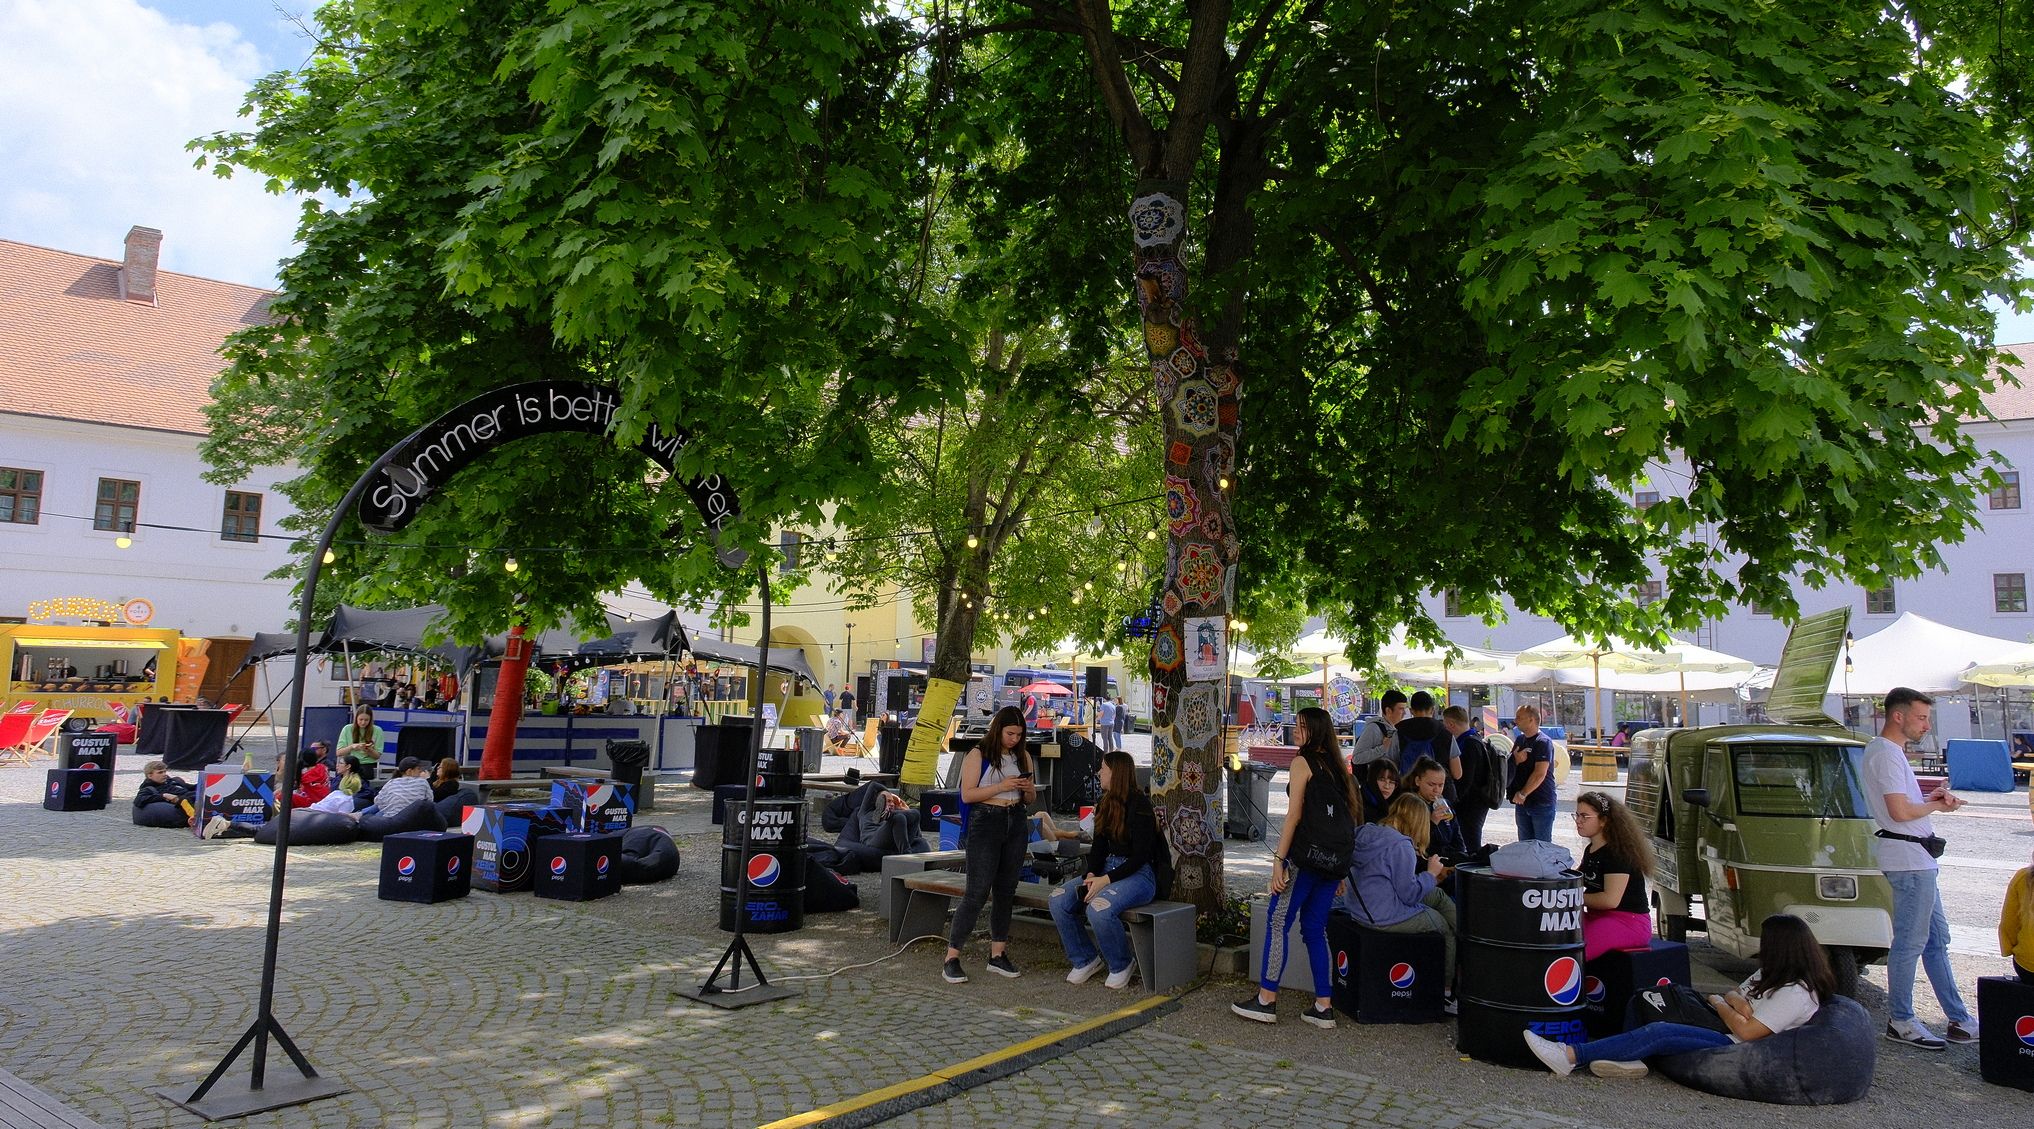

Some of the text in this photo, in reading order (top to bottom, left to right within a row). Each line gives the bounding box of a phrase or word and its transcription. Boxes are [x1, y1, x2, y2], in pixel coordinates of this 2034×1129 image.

[373, 404, 505, 518] Summer
[516, 393, 542, 425] is
[72, 738, 110, 747] GUSTUL
[77, 747, 103, 756] MAX
[757, 752, 774, 761] STUL
[231, 799, 265, 807] GUSTUL
[242, 806, 264, 814] MAX
[604, 808, 629, 816] GUSTUL
[476, 840, 498, 852] GUSTUL
[482, 851, 497, 862] MAX
[1540, 910, 1581, 932] MAX
[1391, 990, 1412, 998] pepsi
